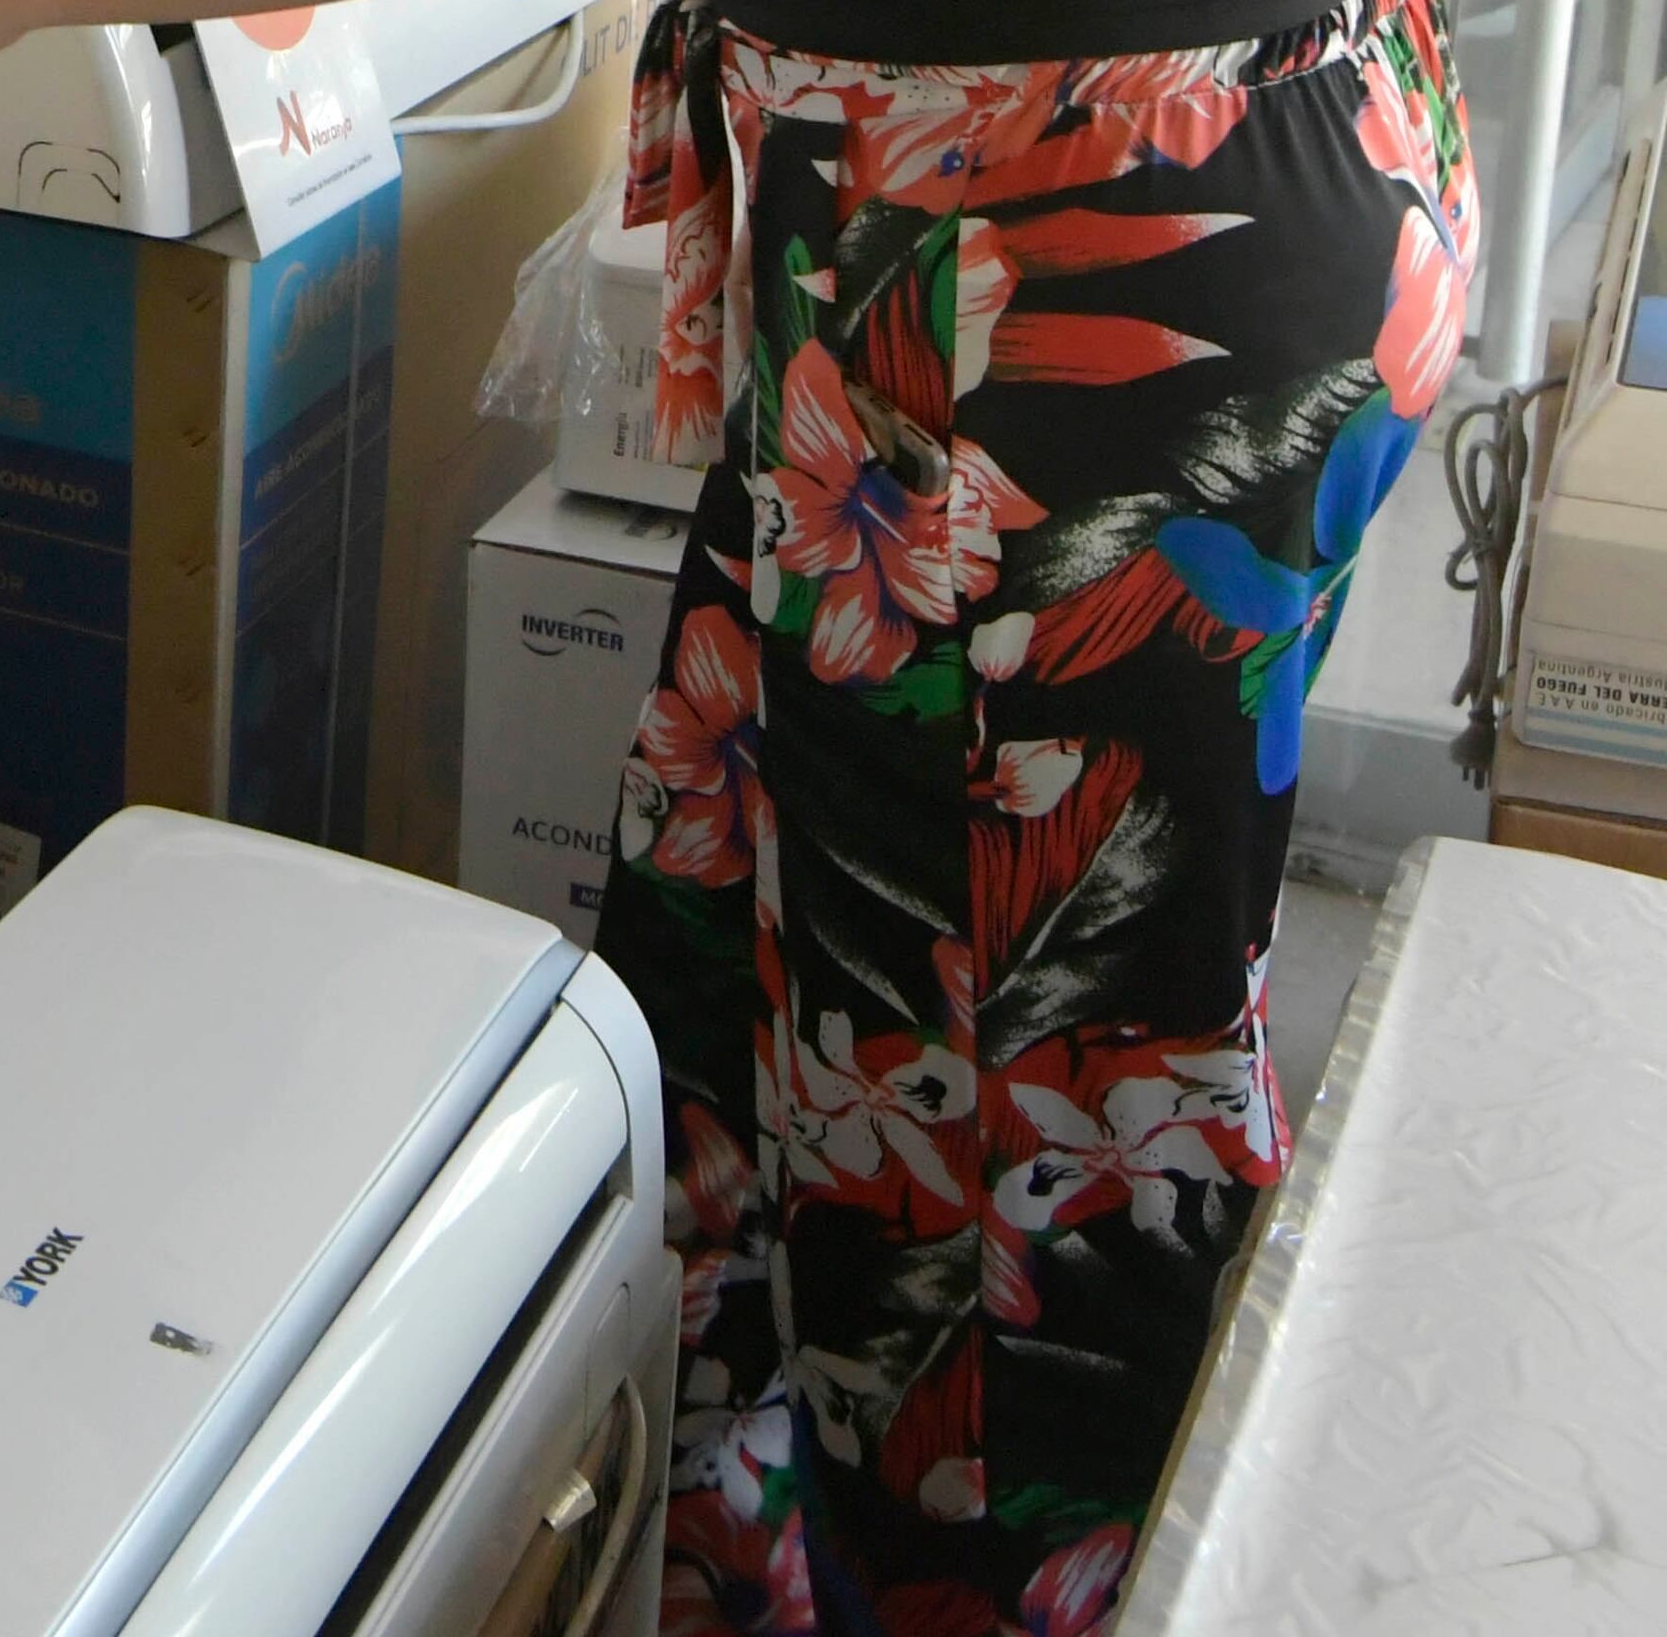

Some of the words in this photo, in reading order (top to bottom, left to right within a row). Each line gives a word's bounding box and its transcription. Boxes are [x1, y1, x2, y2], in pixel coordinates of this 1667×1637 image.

[522, 614, 624, 652] INVERTER
[1538, 660, 1612, 684] Argentina
[1537, 676, 1587, 696] FUEGO
[1593, 685, 1622, 702] DEL
[13, 1226, 84, 1287] YORK
